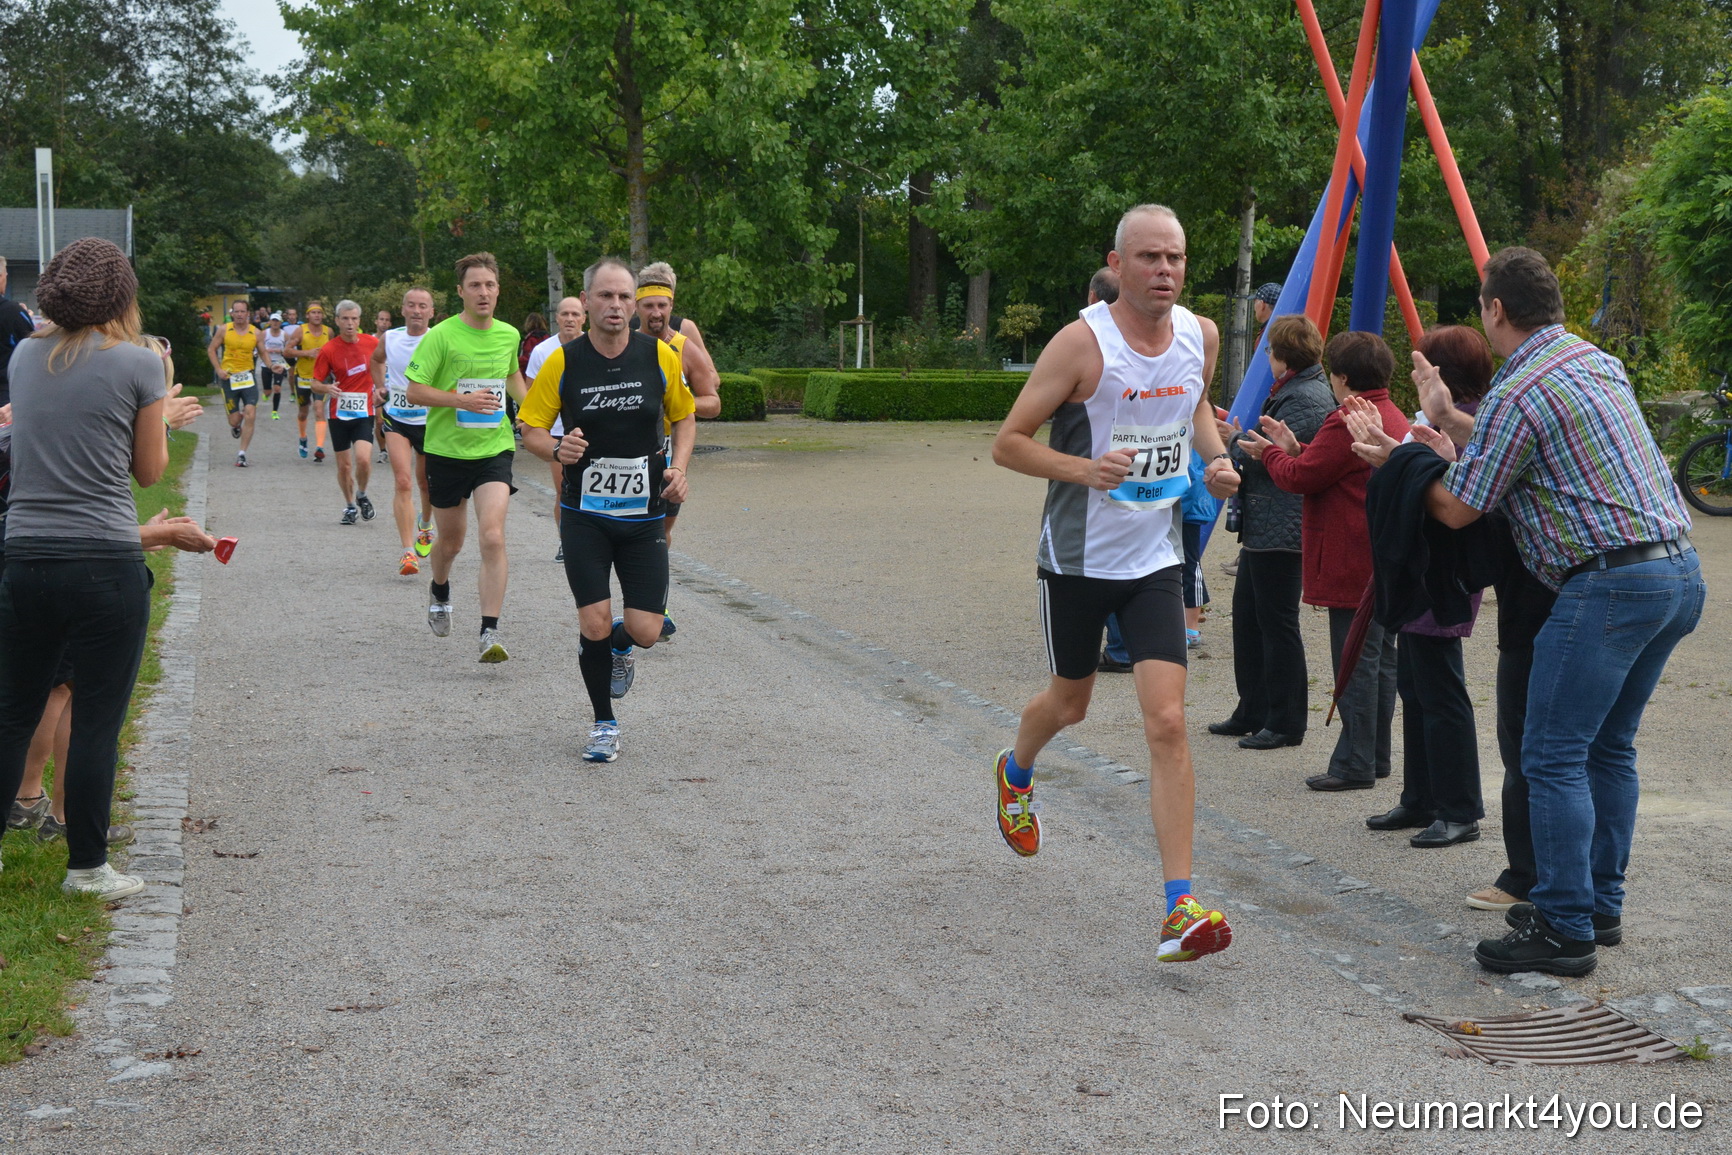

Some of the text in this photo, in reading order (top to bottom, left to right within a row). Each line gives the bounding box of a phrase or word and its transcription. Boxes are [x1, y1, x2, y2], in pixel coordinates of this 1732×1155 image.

[580, 381, 643, 394] REISEBÜRO
[1139, 385, 1187, 400] KLEBL
[340, 399, 365, 411] 2452
[393, 393, 423, 408] 28
[582, 392, 645, 412] Linzer
[1112, 432, 1179, 443] PARTL Neumarkt
[589, 471, 644, 495] 2473
[1136, 486, 1164, 499] Peter
[603, 499, 628, 509] Peter
